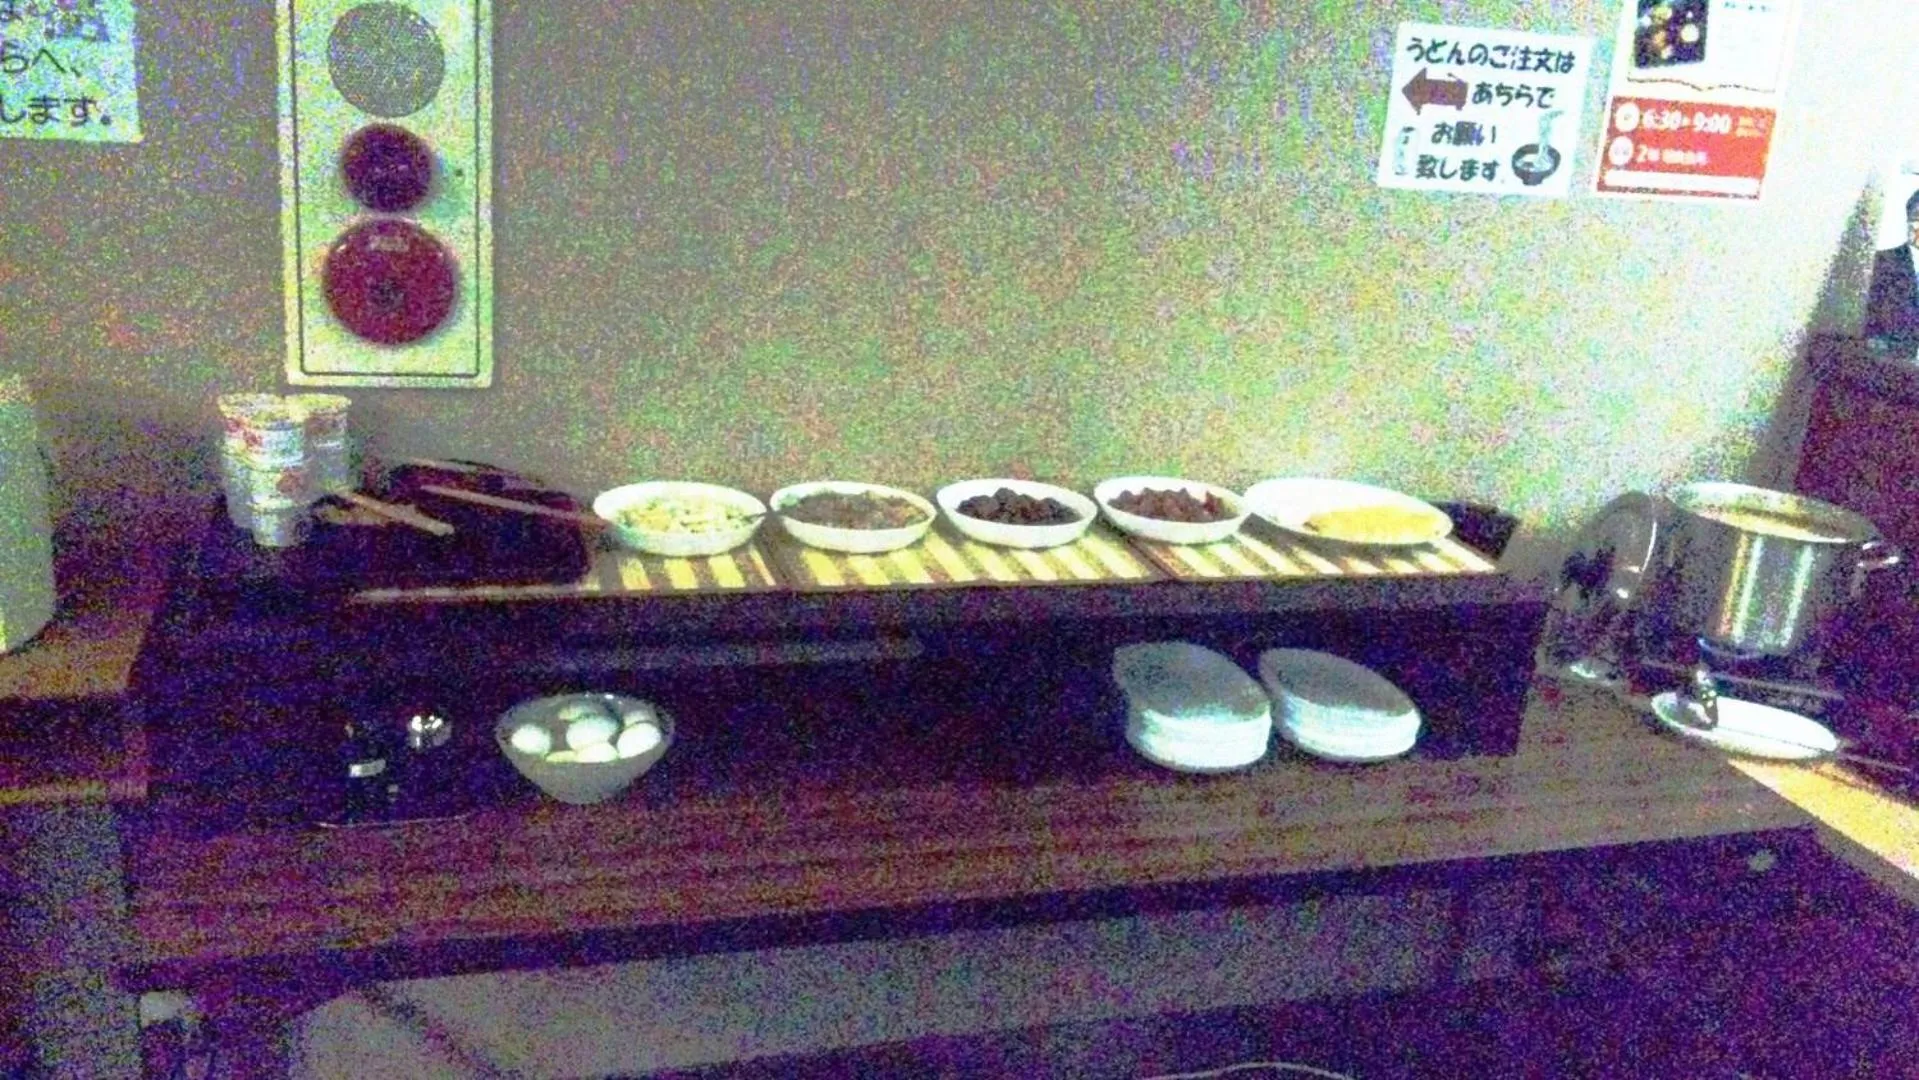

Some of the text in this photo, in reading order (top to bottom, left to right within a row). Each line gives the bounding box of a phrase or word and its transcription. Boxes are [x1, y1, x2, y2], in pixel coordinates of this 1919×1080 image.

[1471, 81, 1556, 109] あちらで
[1430, 121, 1497, 146] お願い
